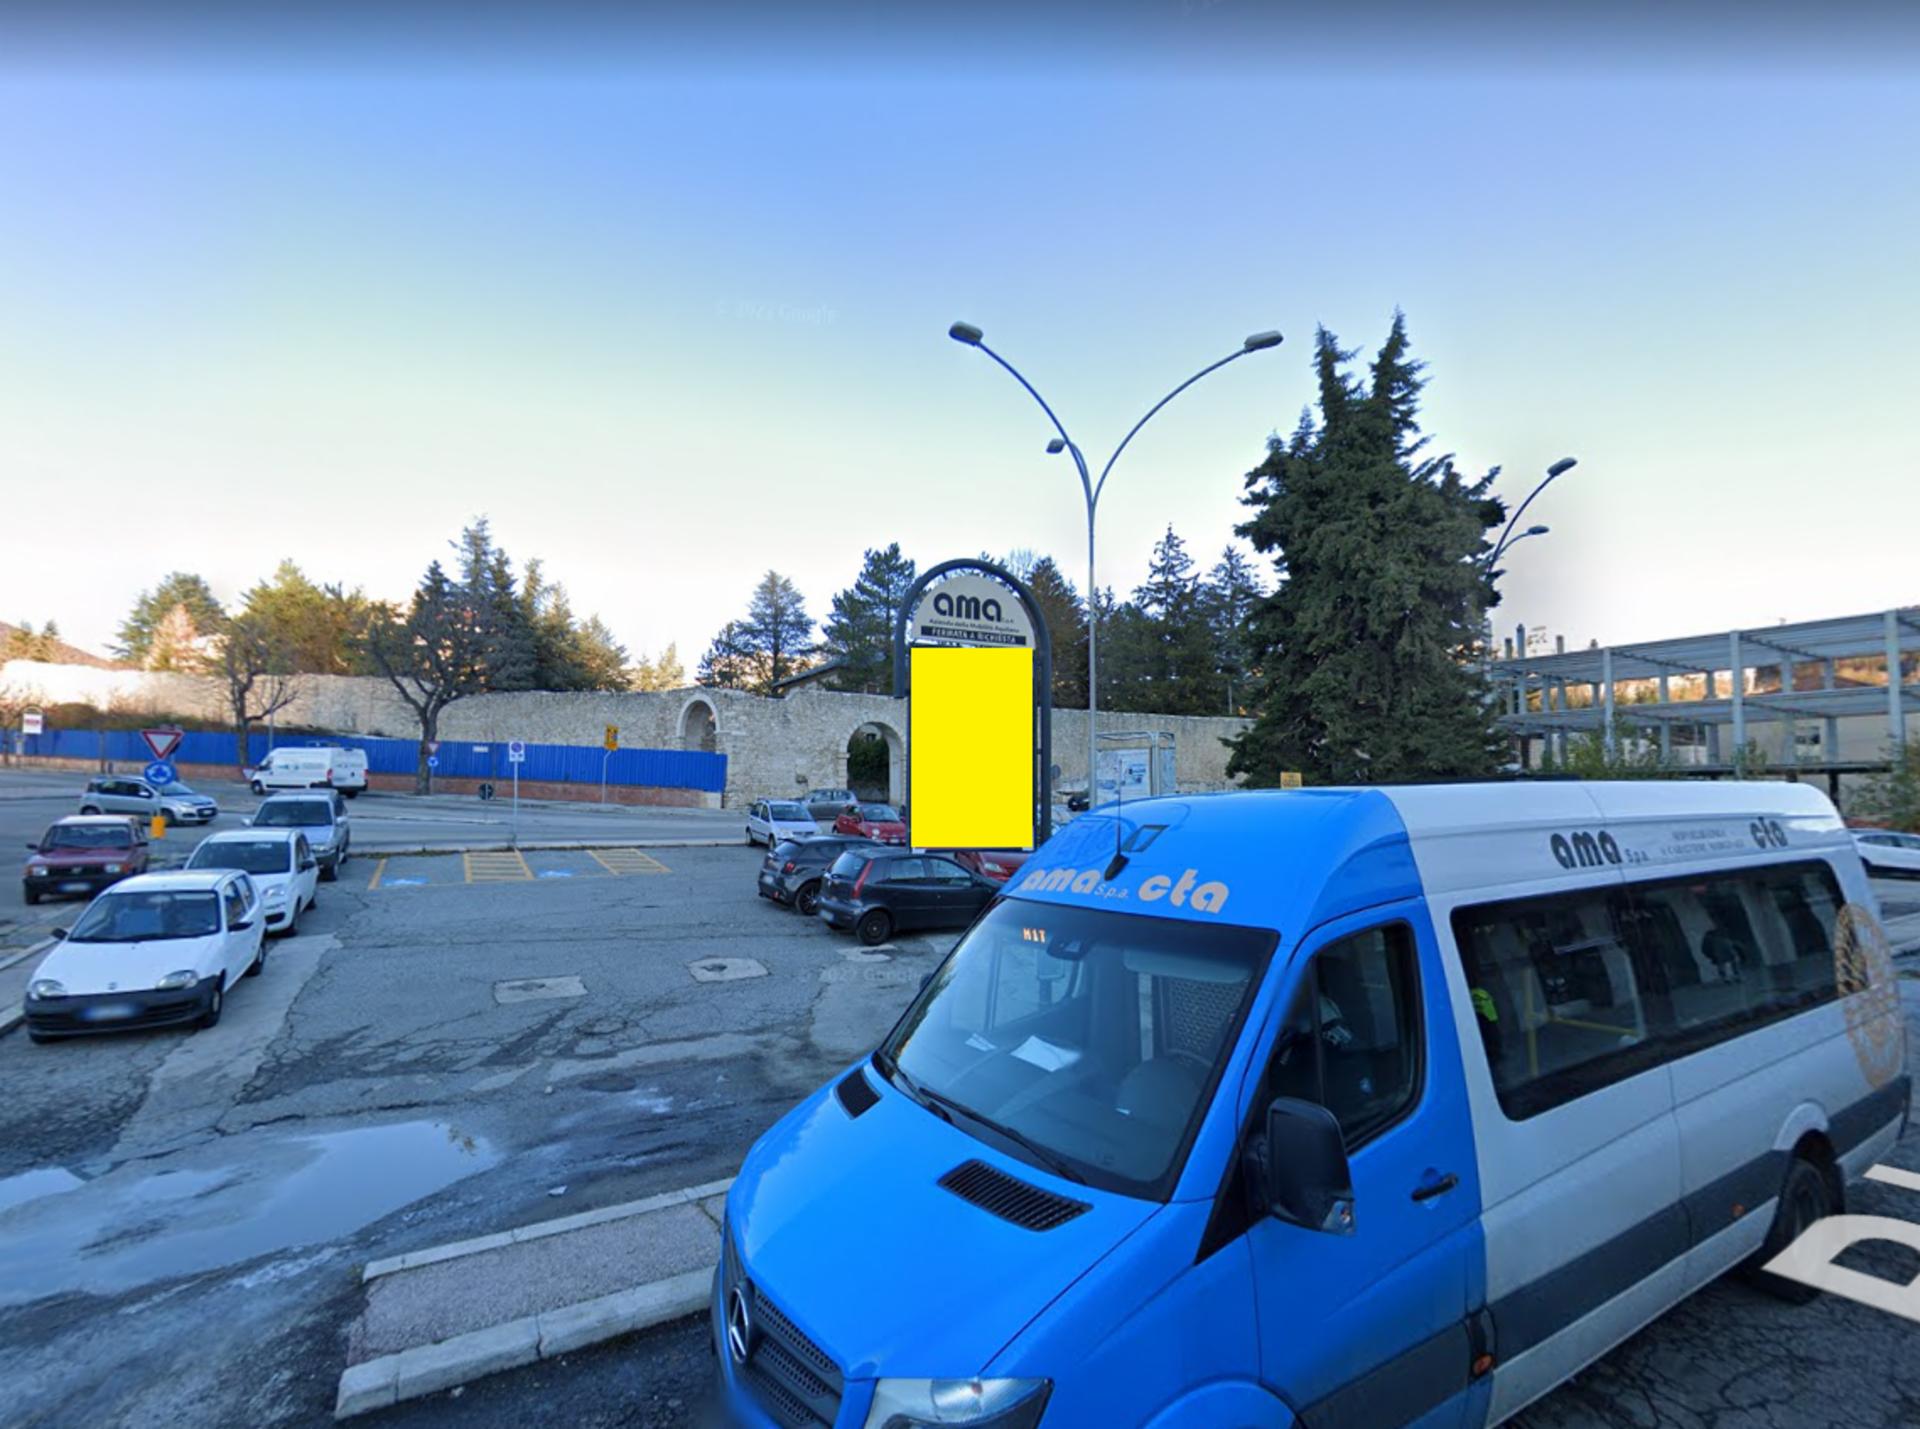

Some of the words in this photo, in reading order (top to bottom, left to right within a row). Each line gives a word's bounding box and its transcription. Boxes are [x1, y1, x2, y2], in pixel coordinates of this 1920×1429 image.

[934, 592, 1001, 622] ama
[932, 628, 968, 639] FERMATA
[969, 631, 976, 639] A
[977, 632, 1016, 644] RICHIESTA
[1550, 830, 1622, 870] ama
[1748, 815, 1789, 850] cta
[1021, 867, 1101, 895] ama
[1138, 869, 1230, 914] cta
